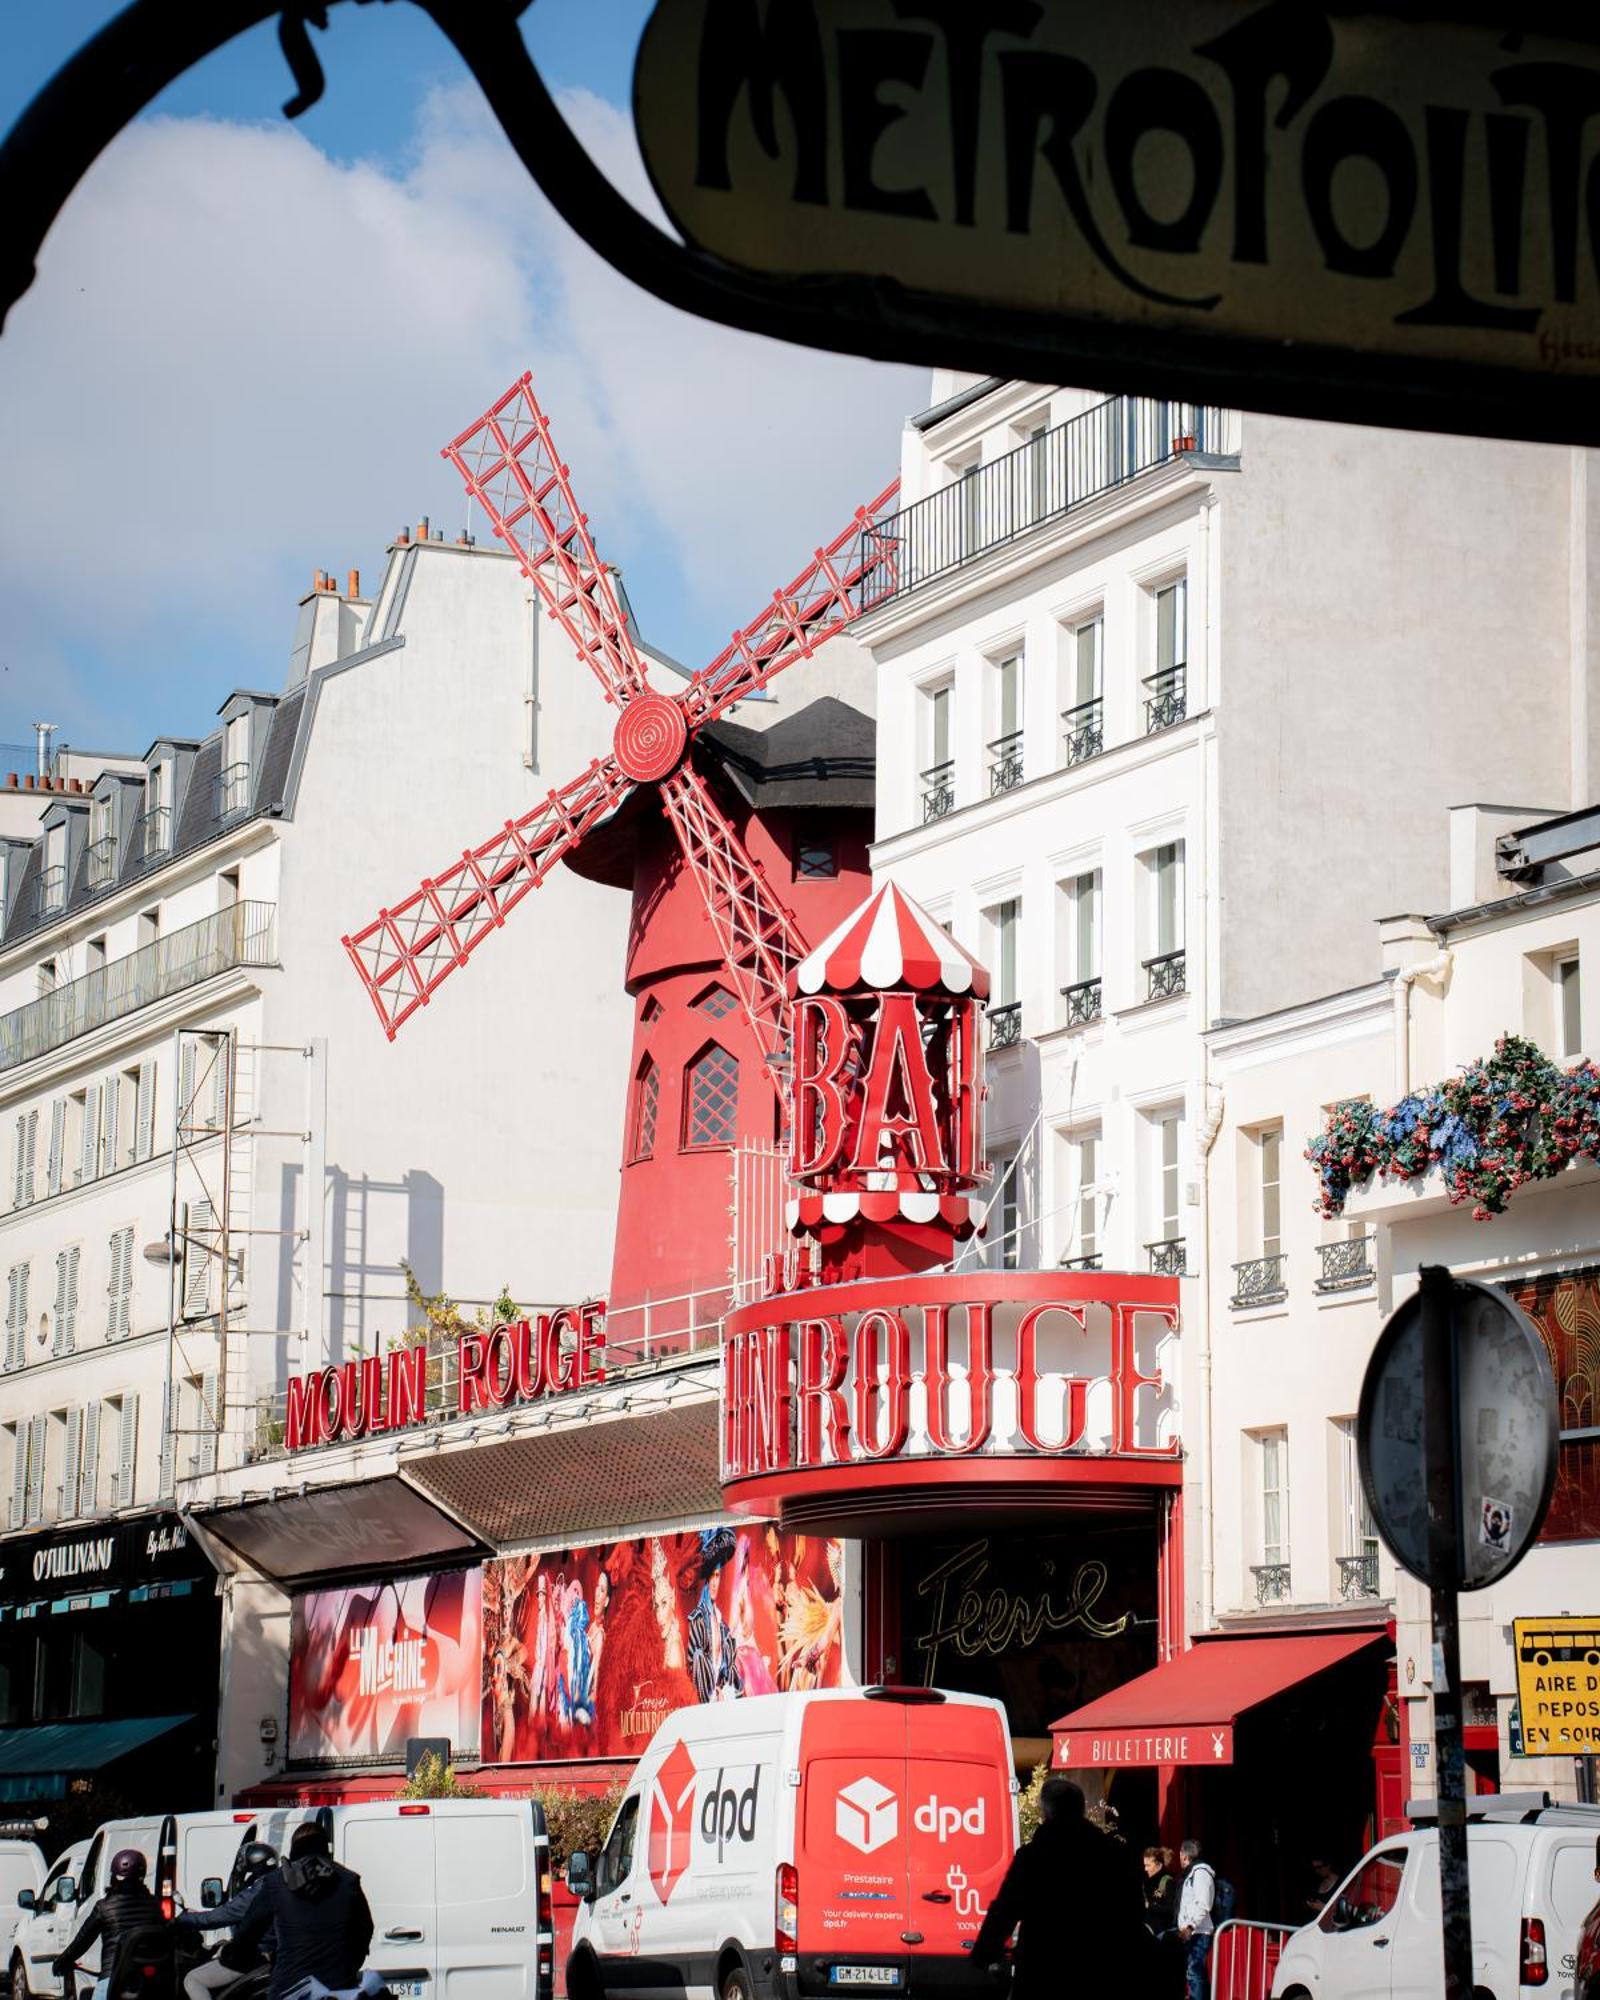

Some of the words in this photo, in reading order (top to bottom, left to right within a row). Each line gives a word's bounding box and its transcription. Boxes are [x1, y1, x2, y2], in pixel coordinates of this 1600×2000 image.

[695, 0, 1600, 332] METROPOLIT
[285, 1345, 427, 1451] MOULIN
[458, 1299, 606, 1413] ROUGE
[796, 1301, 1182, 1467] ROUGE
[1535, 1676, 1576, 1692] AIRE
[1586, 1675, 1600, 1691] D
[1092, 1736, 1188, 1762] BILLETTERIE
[701, 1763, 762, 1865] dpd
[914, 1794, 986, 1843] dpd
[843, 1873, 895, 1885] Prestataire
[822, 1909, 842, 1918] Your
[842, 1910, 873, 1921] delivery
[491, 1926, 526, 1934] RENAULT
[837, 1966, 891, 1982] GM-214-LE
